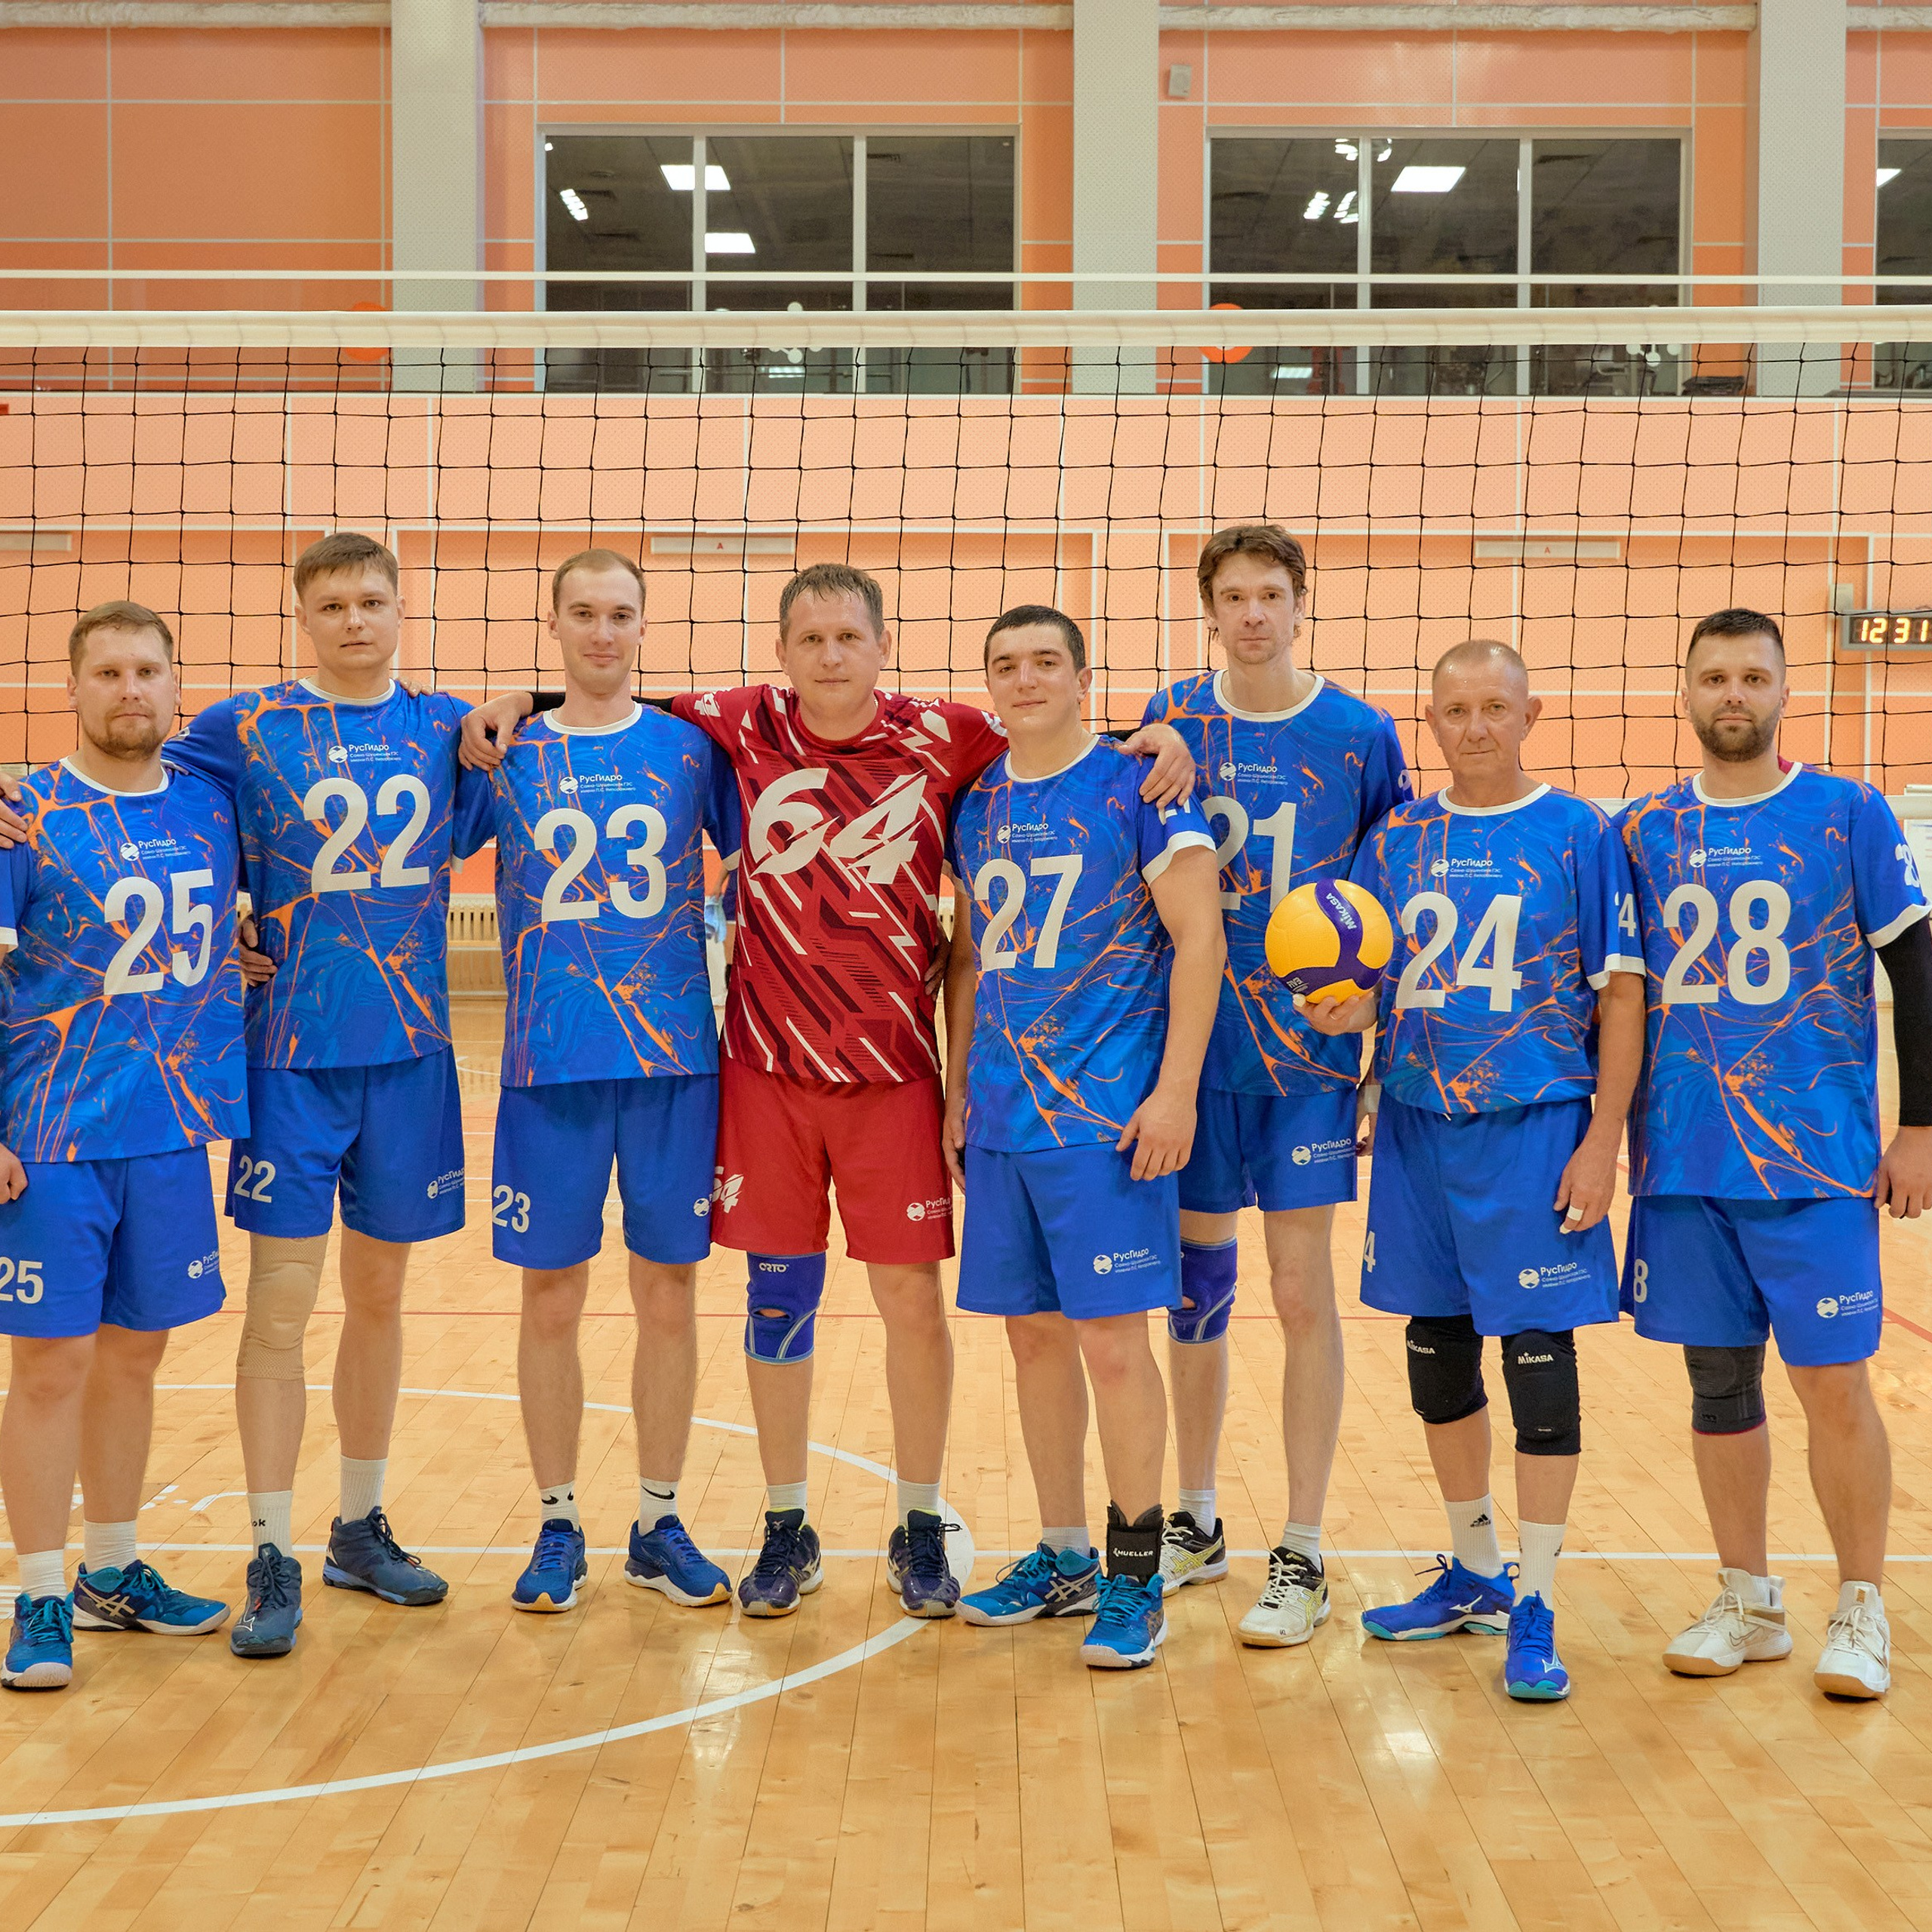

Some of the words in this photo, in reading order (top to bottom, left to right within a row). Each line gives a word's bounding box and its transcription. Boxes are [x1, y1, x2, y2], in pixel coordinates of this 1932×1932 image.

[349, 743, 389, 752] РусГидро
[1238, 762, 1278, 774] РусГидро
[580, 774, 623, 783] РусГидро
[138, 838, 177, 849] РусГидро
[303, 774, 430, 893] 22
[749, 767, 928, 884] 64
[1012, 823, 1049, 832] РусГидро
[534, 804, 667, 922] 23
[1203, 795, 1297, 913] 21
[1451, 858, 1493, 867] РусГидро
[1708, 847, 1752, 857] РусГидро
[103, 869, 214, 995] 25
[974, 854, 1083, 971] 27
[1614, 891, 1636, 937] 4
[1395, 891, 1522, 1012] 24
[1663, 880, 1791, 1005] 28
[234, 1155, 275, 1203] 22
[493, 1185, 531, 1232] 23
[0, 1257, 44, 1304] 25
